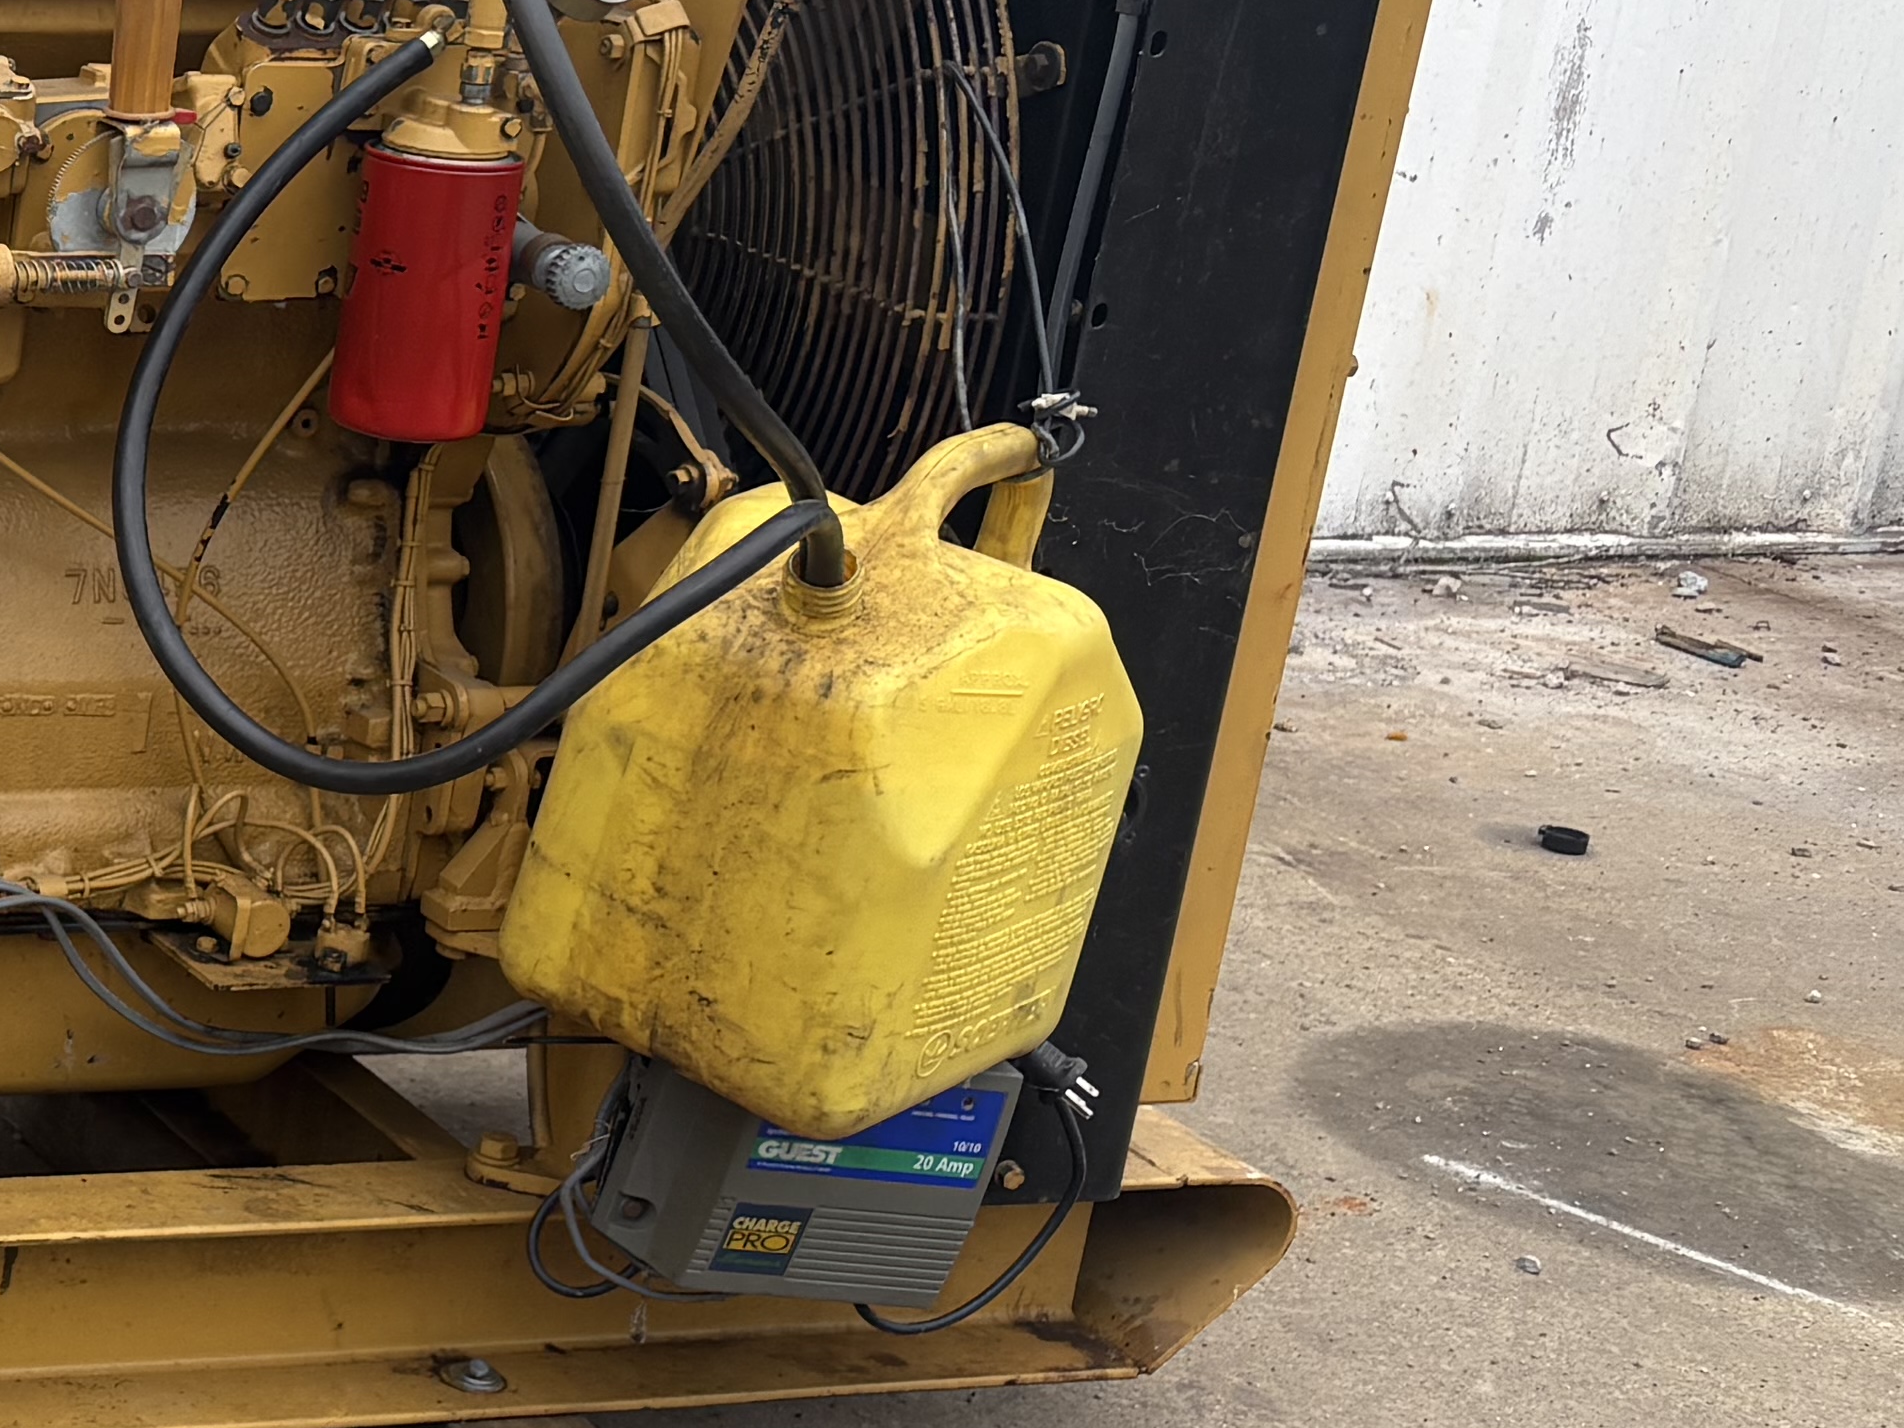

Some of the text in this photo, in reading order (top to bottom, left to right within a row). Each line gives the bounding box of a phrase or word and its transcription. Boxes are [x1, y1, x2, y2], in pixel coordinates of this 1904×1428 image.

[64, 564, 221, 605] 7N6
[757, 1140, 843, 1165] GUEST
[952, 1140, 982, 1154] 10/10
[913, 1154, 974, 1177] 20 Amp
[732, 1216, 802, 1234] CHARGE
[726, 1231, 790, 1252] PRO
